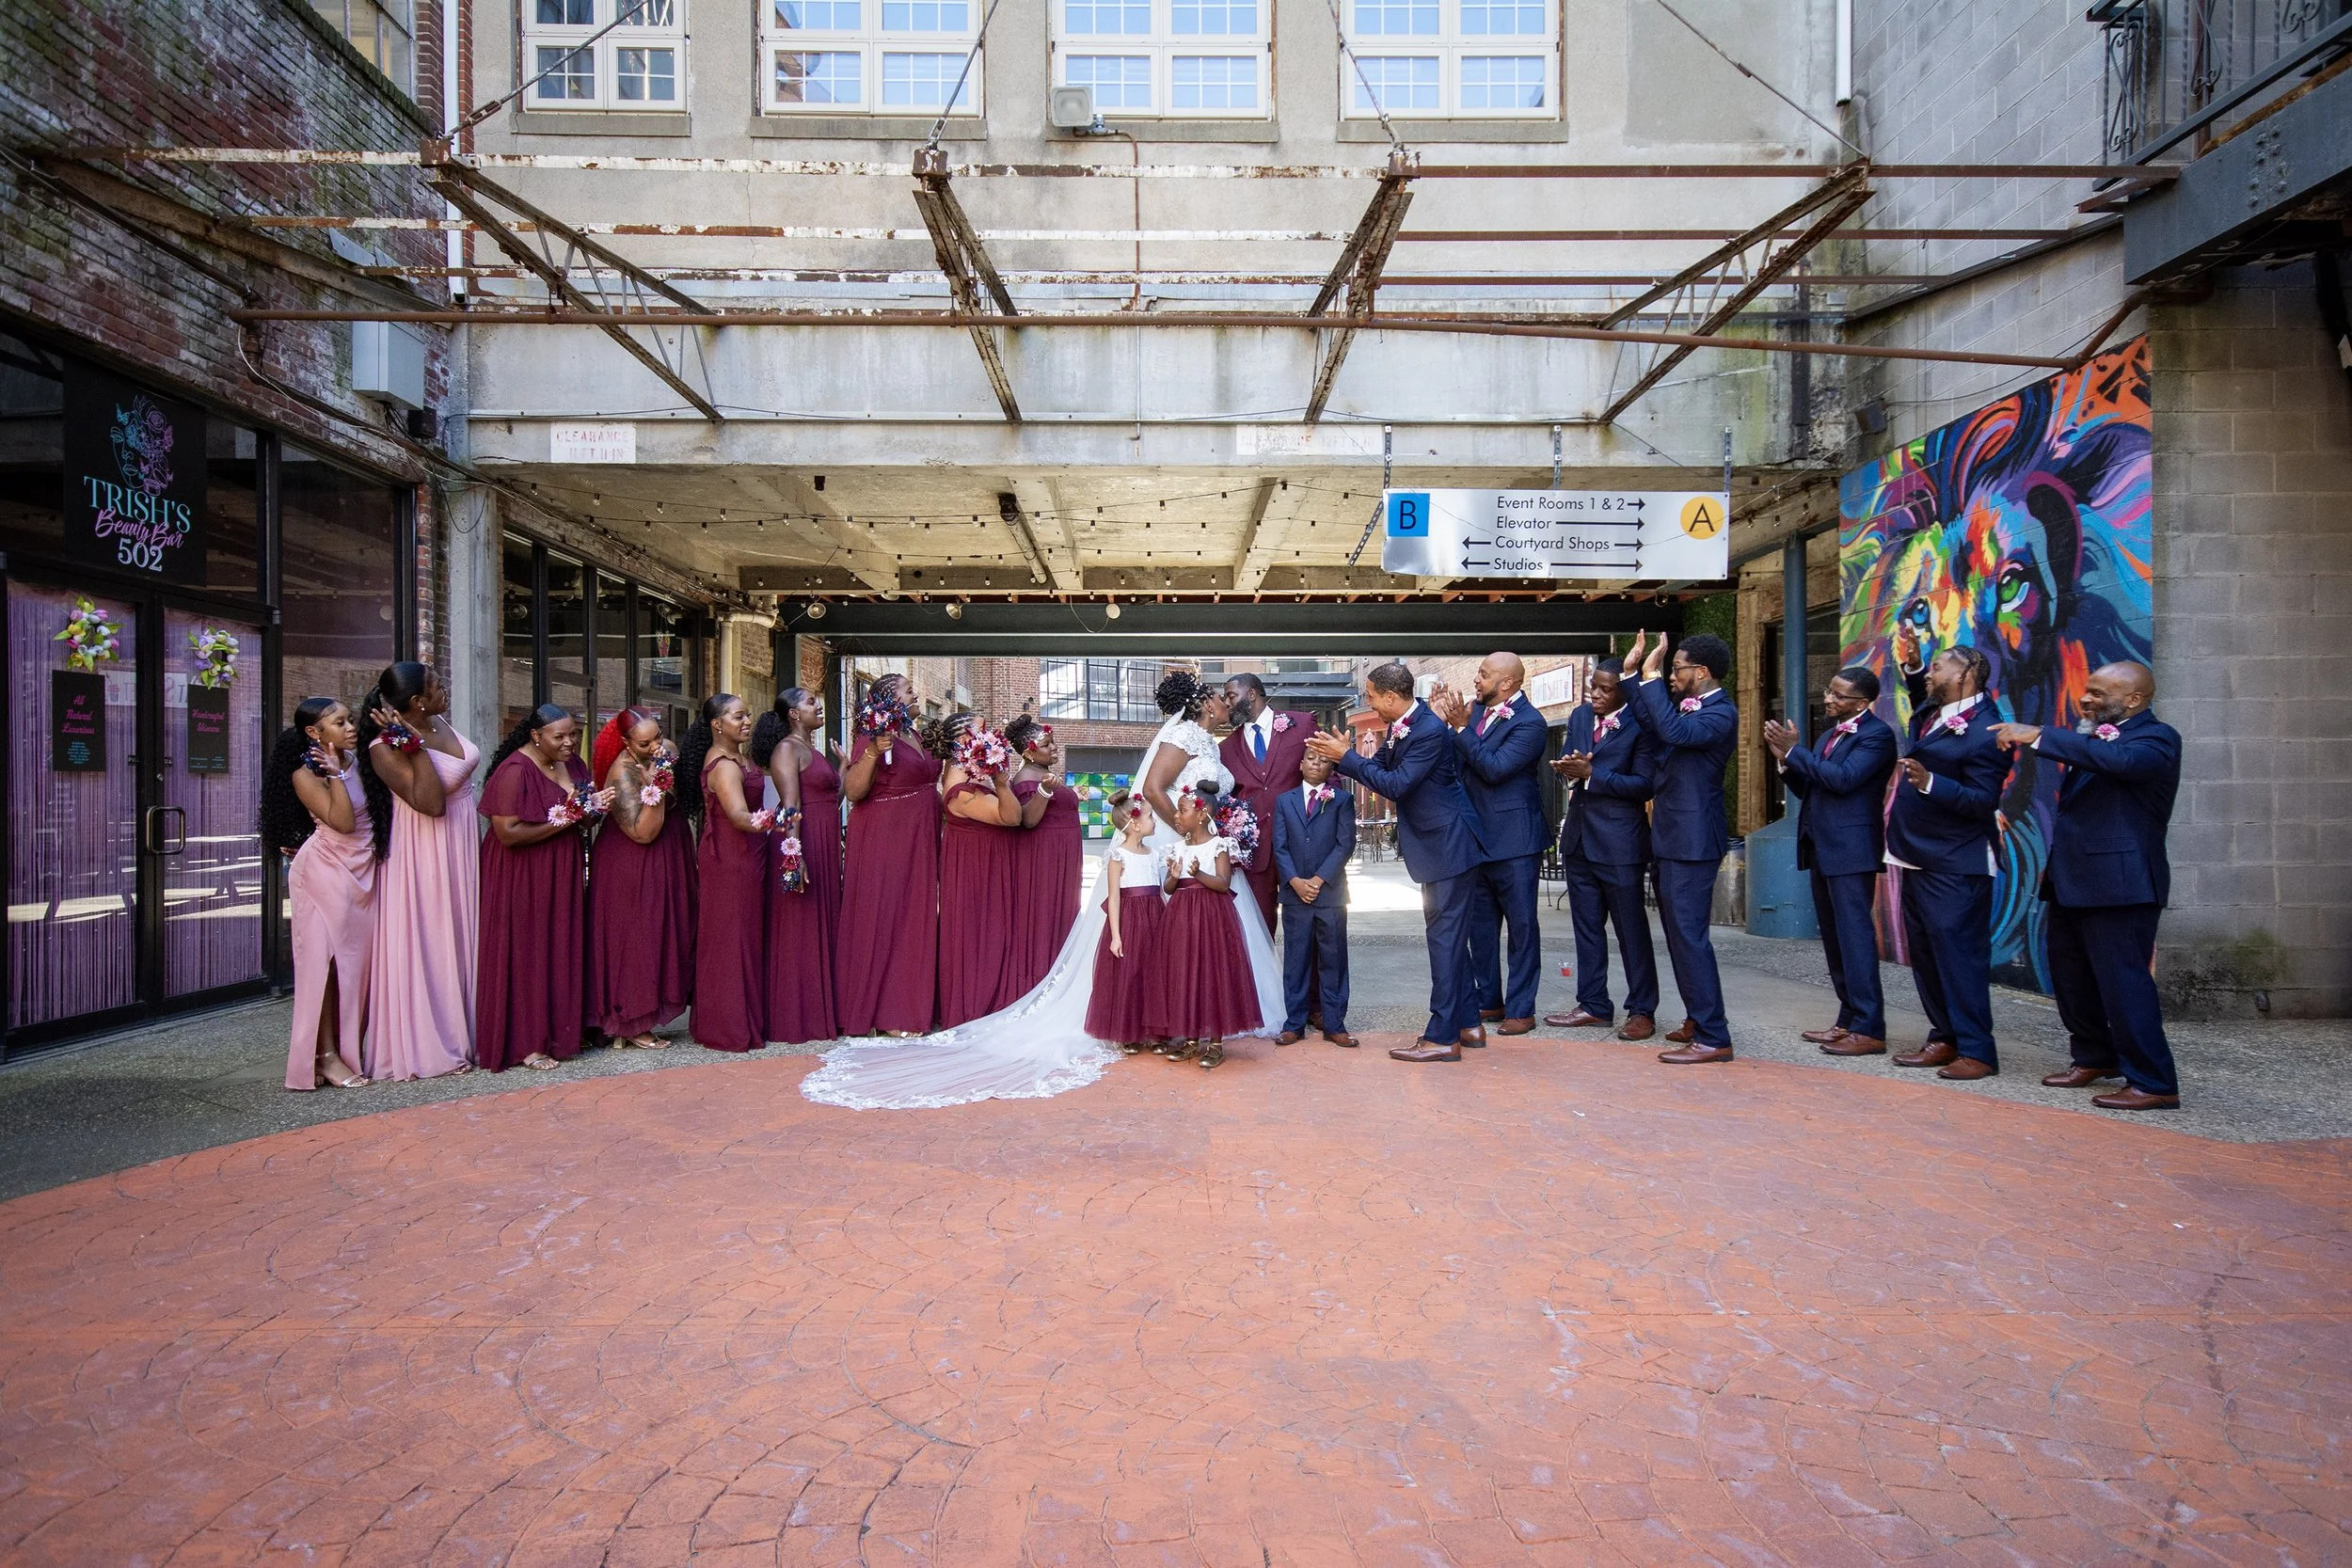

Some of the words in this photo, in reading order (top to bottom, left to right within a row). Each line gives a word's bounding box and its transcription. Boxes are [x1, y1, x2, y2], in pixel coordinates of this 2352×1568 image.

[84, 475, 191, 533] TRISH'S
[1399, 499, 1417, 531] B
[1497, 496, 1534, 510] Event
[1538, 497, 1584, 510] Rooms
[1590, 498, 1596, 510] 1
[1601, 498, 1613, 510] &
[1616, 498, 1625, 510] 2
[1689, 502, 1715, 532] A
[95, 506, 151, 545] Beauty
[150, 522, 184, 549] Bar
[1496, 515, 1552, 530] Elevator
[118, 537, 163, 572] 502
[1495, 536, 1564, 551] Courtyard
[1568, 536, 1610, 552] Shops
[1494, 557, 1544, 571] Studios
